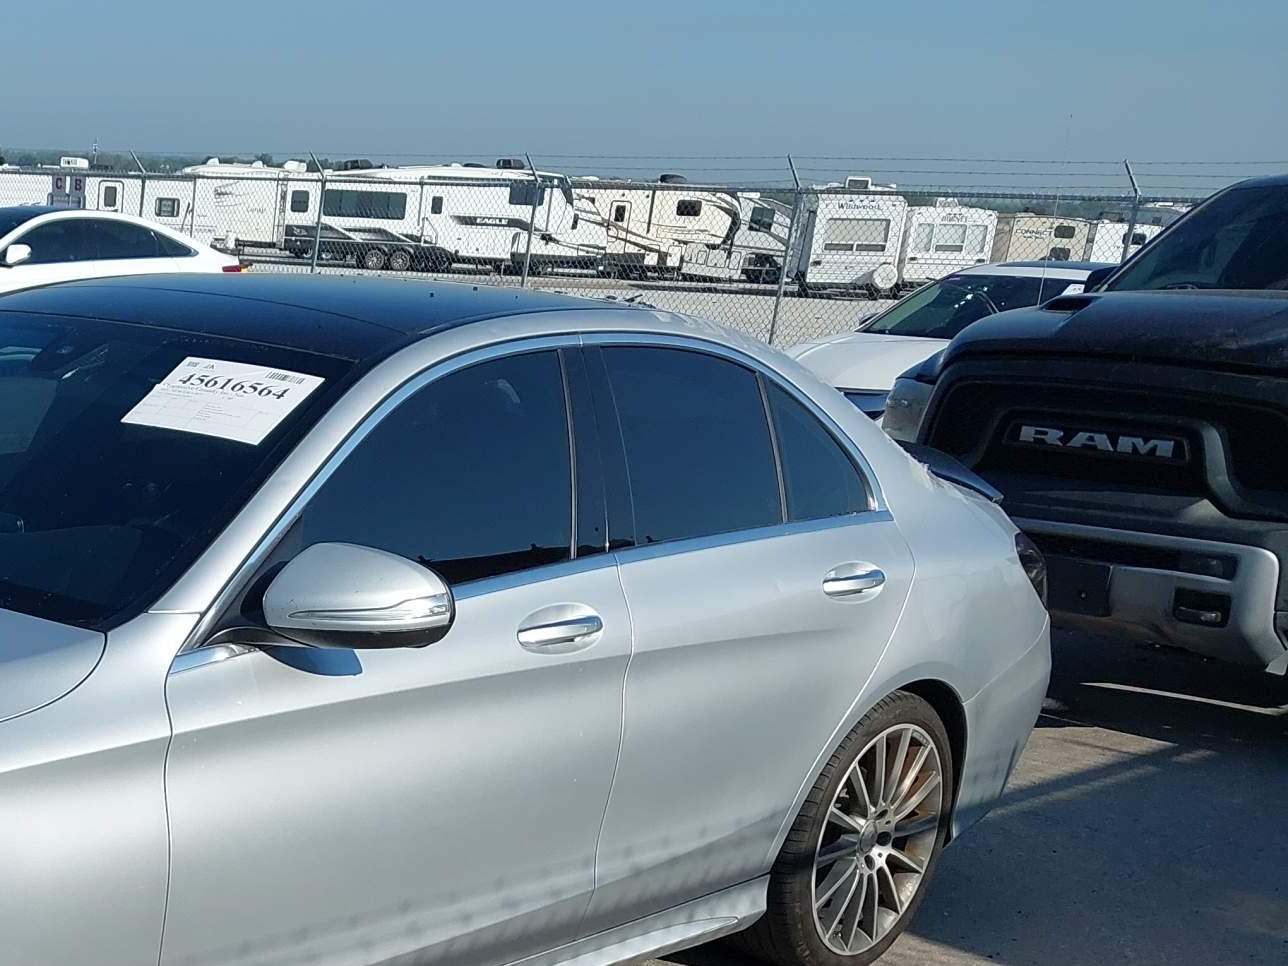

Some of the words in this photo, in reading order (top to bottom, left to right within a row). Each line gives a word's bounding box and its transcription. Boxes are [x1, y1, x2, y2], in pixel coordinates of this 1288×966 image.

[55, 177, 63, 190] C
[74, 178, 82, 191] B
[476, 217, 509, 225] EAGLE
[178, 372, 290, 400] 45616564
[1018, 425, 1175, 458] RAM
